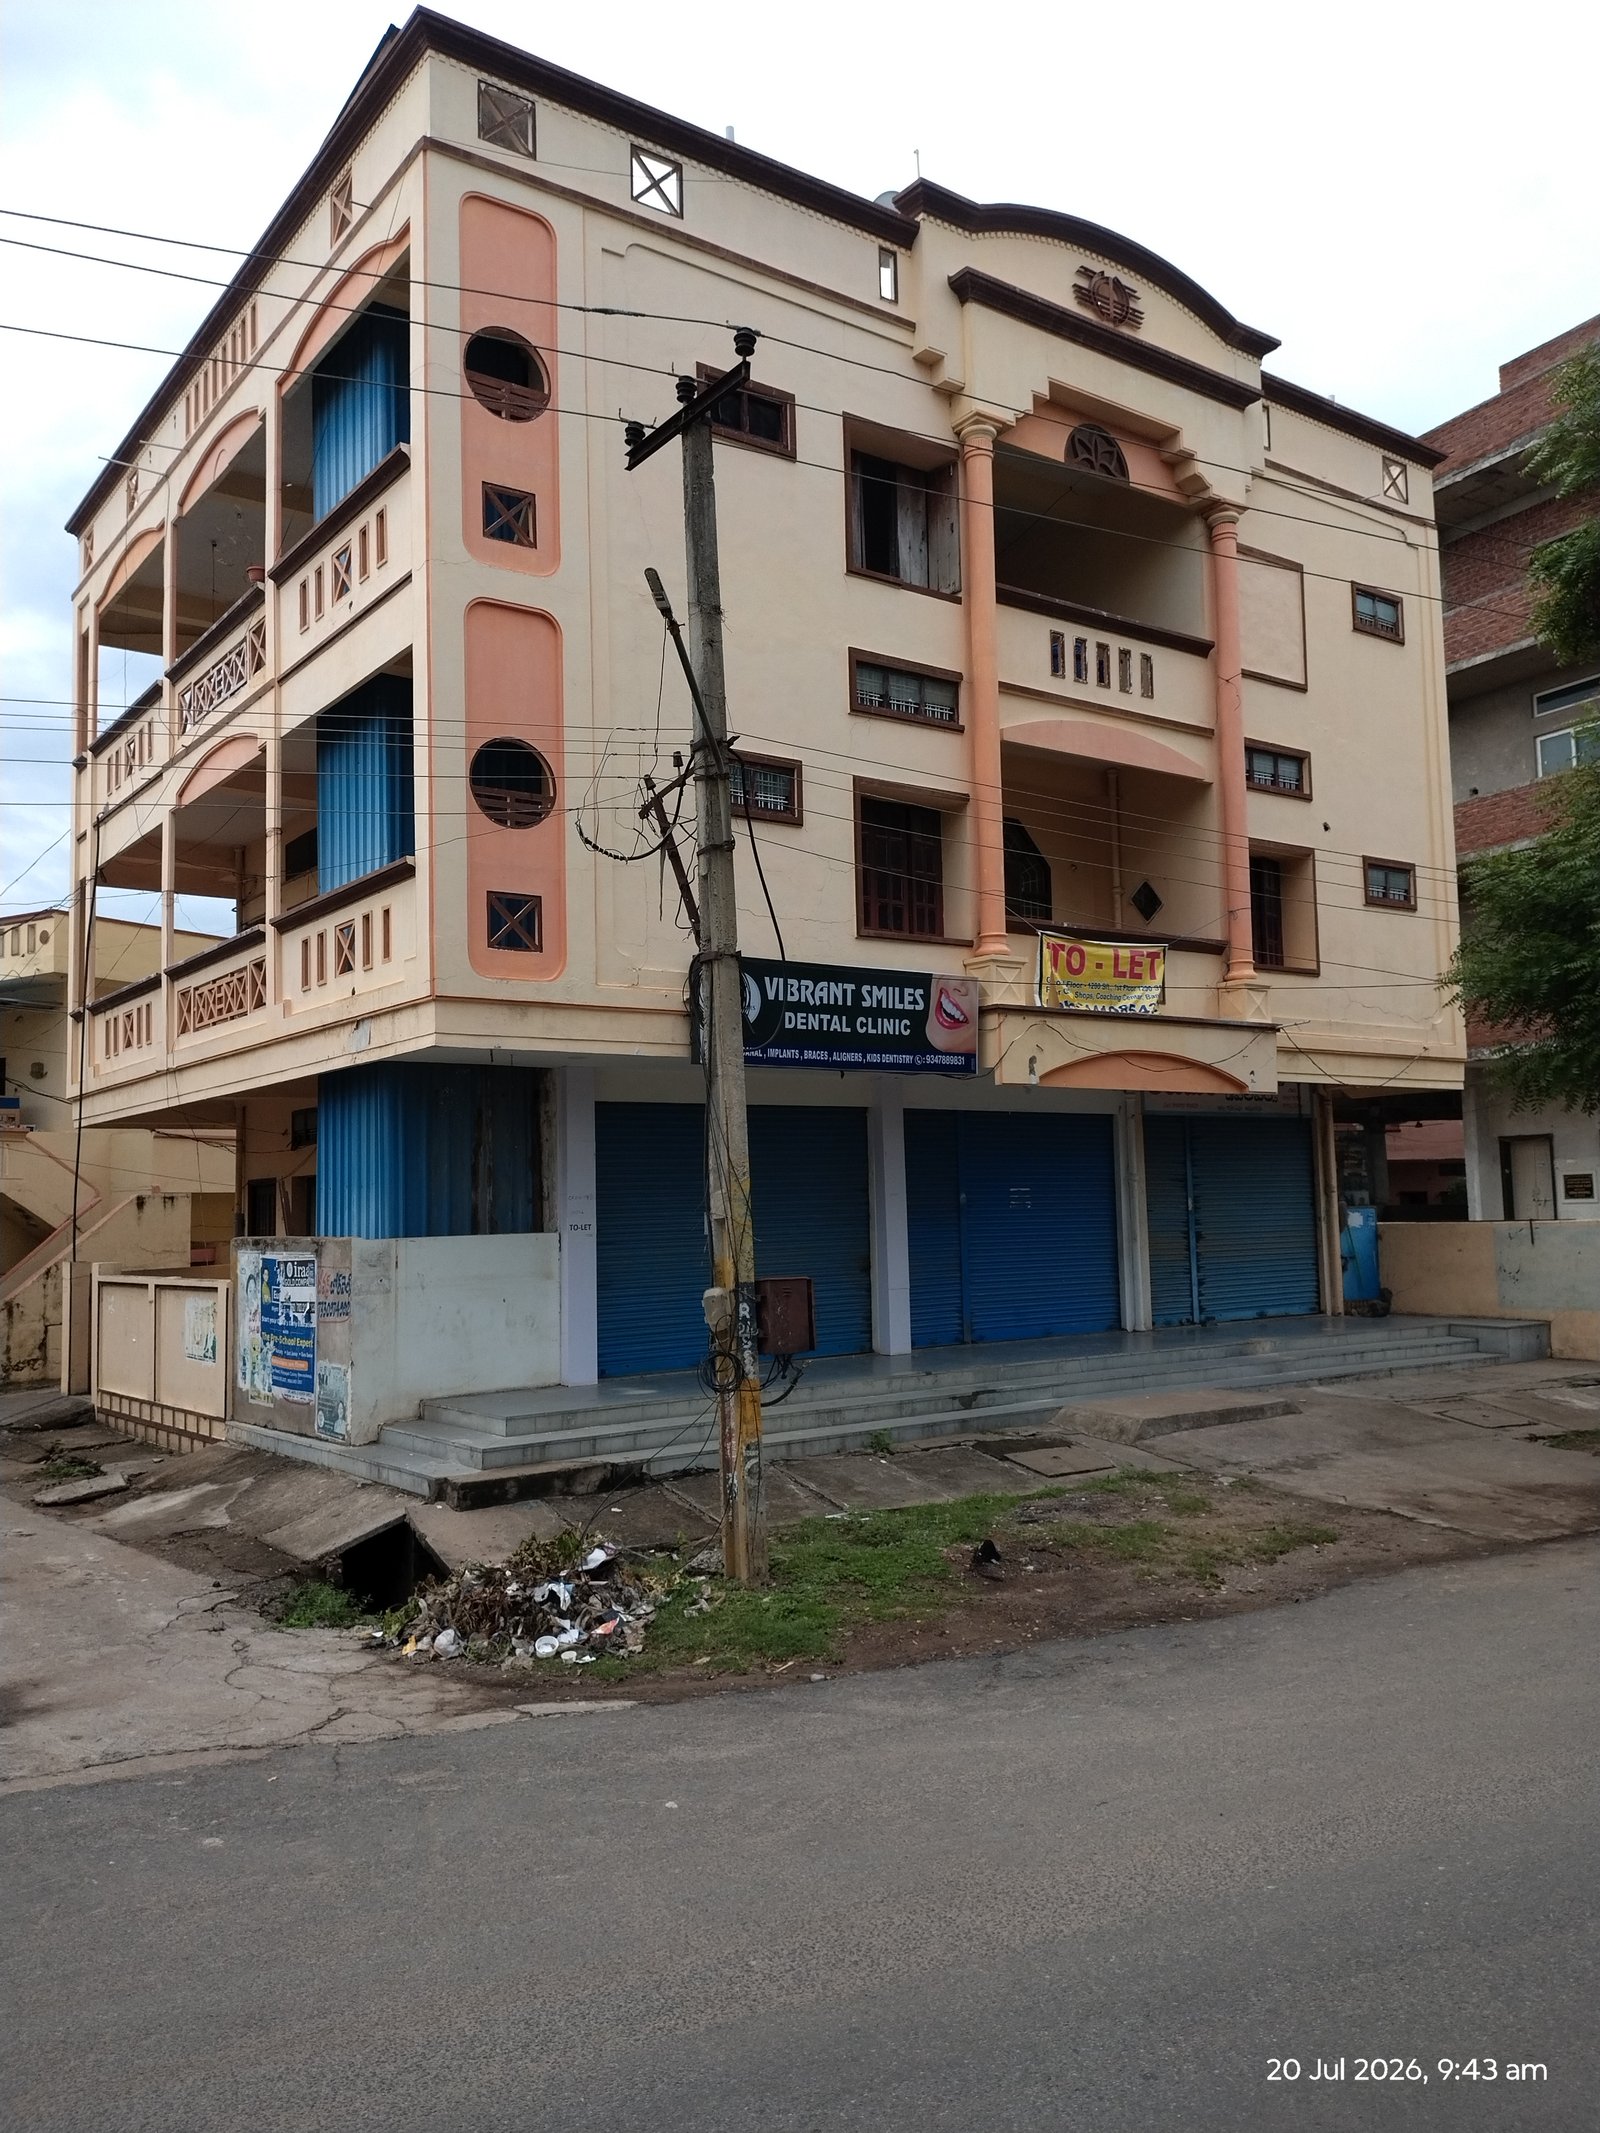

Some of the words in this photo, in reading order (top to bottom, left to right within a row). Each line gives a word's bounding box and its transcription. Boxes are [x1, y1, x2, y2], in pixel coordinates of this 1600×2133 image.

[1046, 942, 1086, 976] TO
[1113, 948, 1162, 981] LET
[764, 976, 856, 1007] VIBRANT
[861, 984, 924, 1011] SMILES
[1096, 993, 1122, 1002] Coaching
[784, 1011, 851, 1033] DENTAL
[856, 1016, 911, 1037] CLINIC
[767, 1048, 799, 1059] IMPLANTS
[804, 1050, 828, 1060] BRACES
[833, 1051, 862, 1062] ALIGNERS
[867, 1053, 881, 1062] KIDS
[882, 1053, 914, 1064] DENTISTRY
[568, 1223, 592, 1231] TO-LET
[271, 1333, 296, 1346] Pre-School
[297, 1338, 313, 1348] Expert
